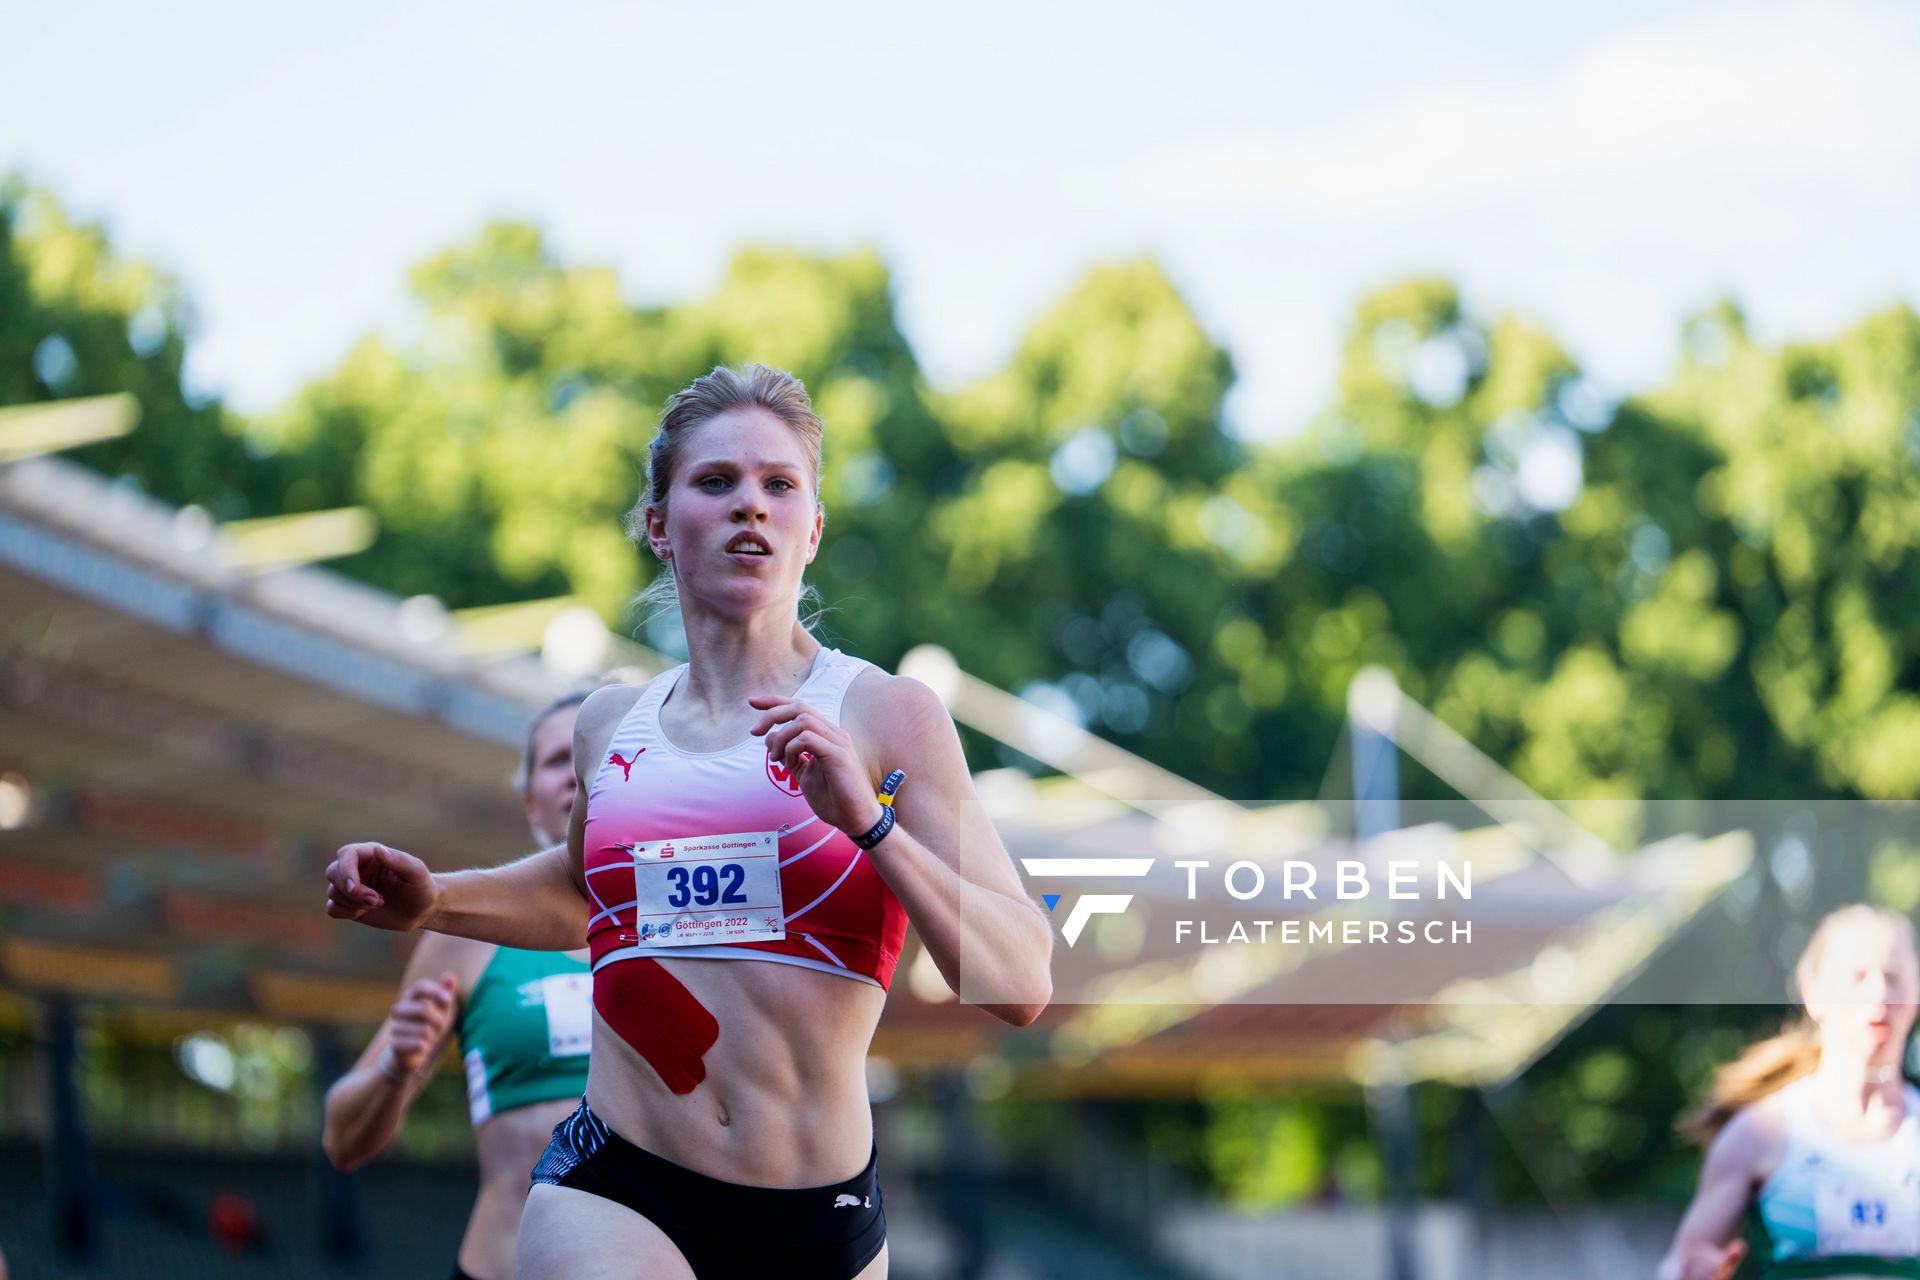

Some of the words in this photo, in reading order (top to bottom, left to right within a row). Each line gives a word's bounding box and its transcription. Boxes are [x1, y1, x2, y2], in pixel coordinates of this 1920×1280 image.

[683, 844, 720, 853] Sparkasse
[721, 841, 757, 850] Göttingen
[667, 864, 747, 908] 392
[675, 920, 722, 931] Göttingen
[725, 917, 748, 927] 2022
